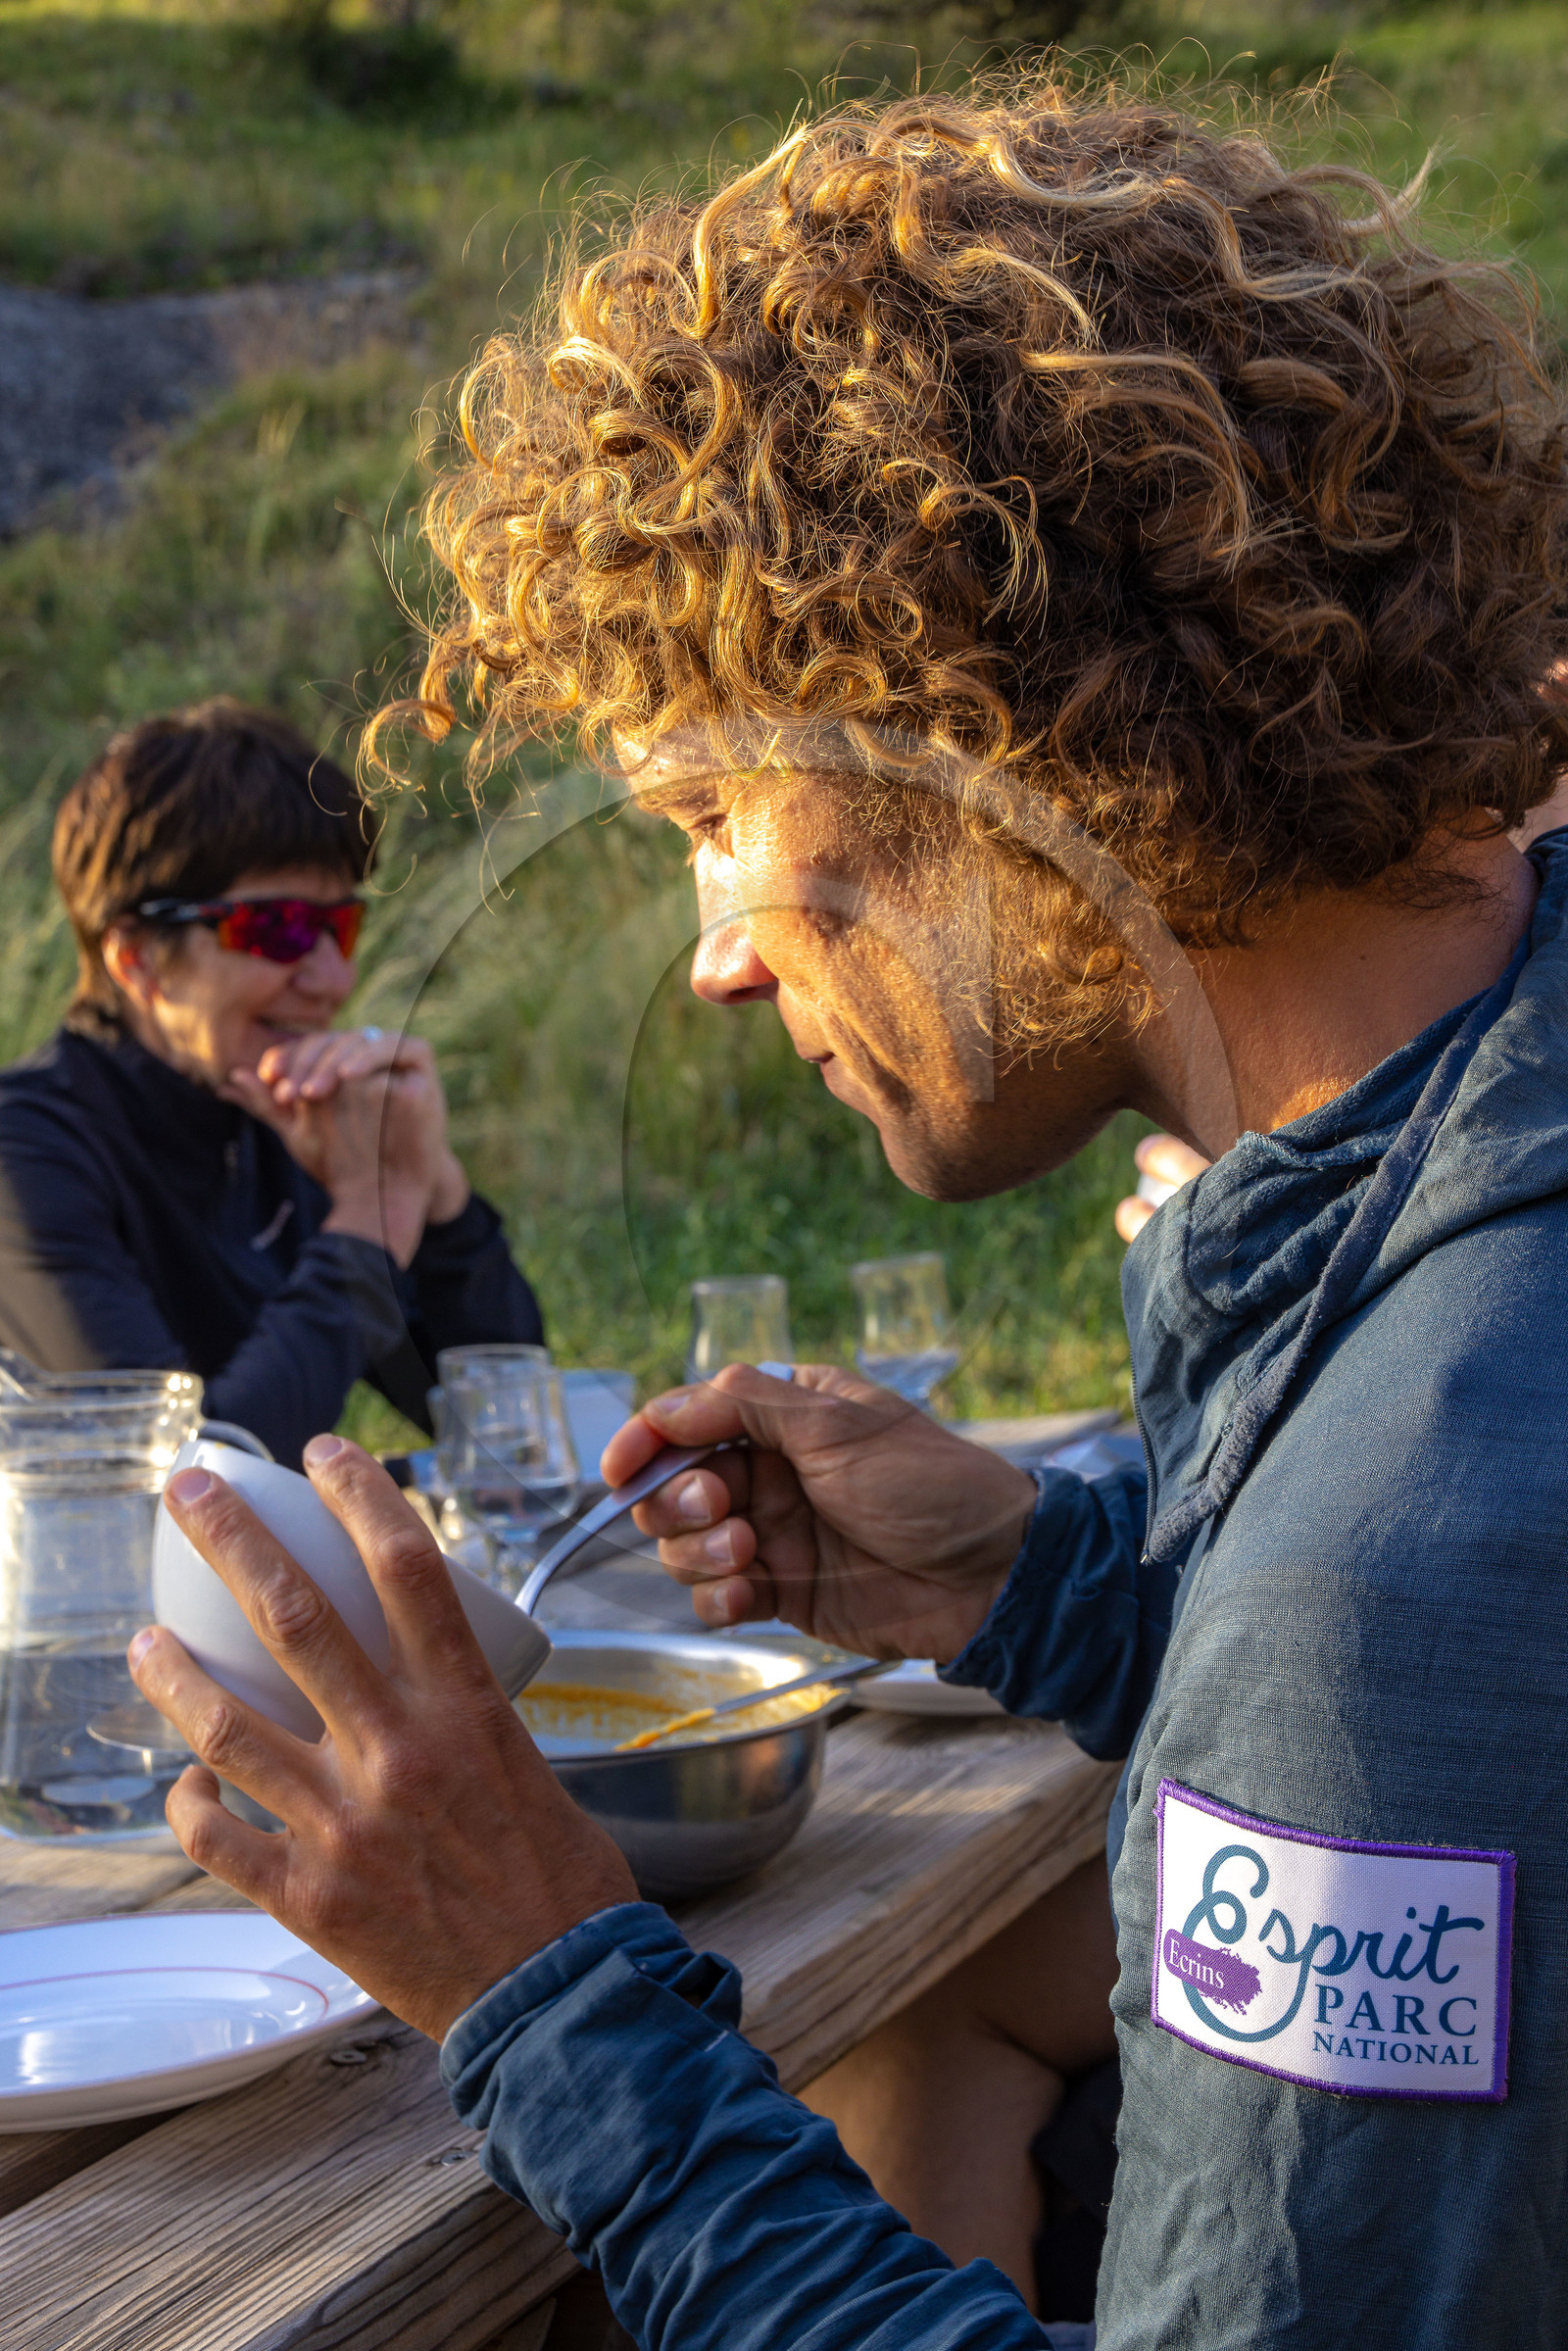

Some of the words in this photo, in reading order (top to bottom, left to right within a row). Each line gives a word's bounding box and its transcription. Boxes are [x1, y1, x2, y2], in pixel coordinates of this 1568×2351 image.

[1168, 1937, 1225, 1989] Ecrins
[1181, 1843, 1486, 2043] Esprit
[1314, 1984, 1478, 2037] PARC
[1312, 2032, 1480, 2065] NATIONAL
